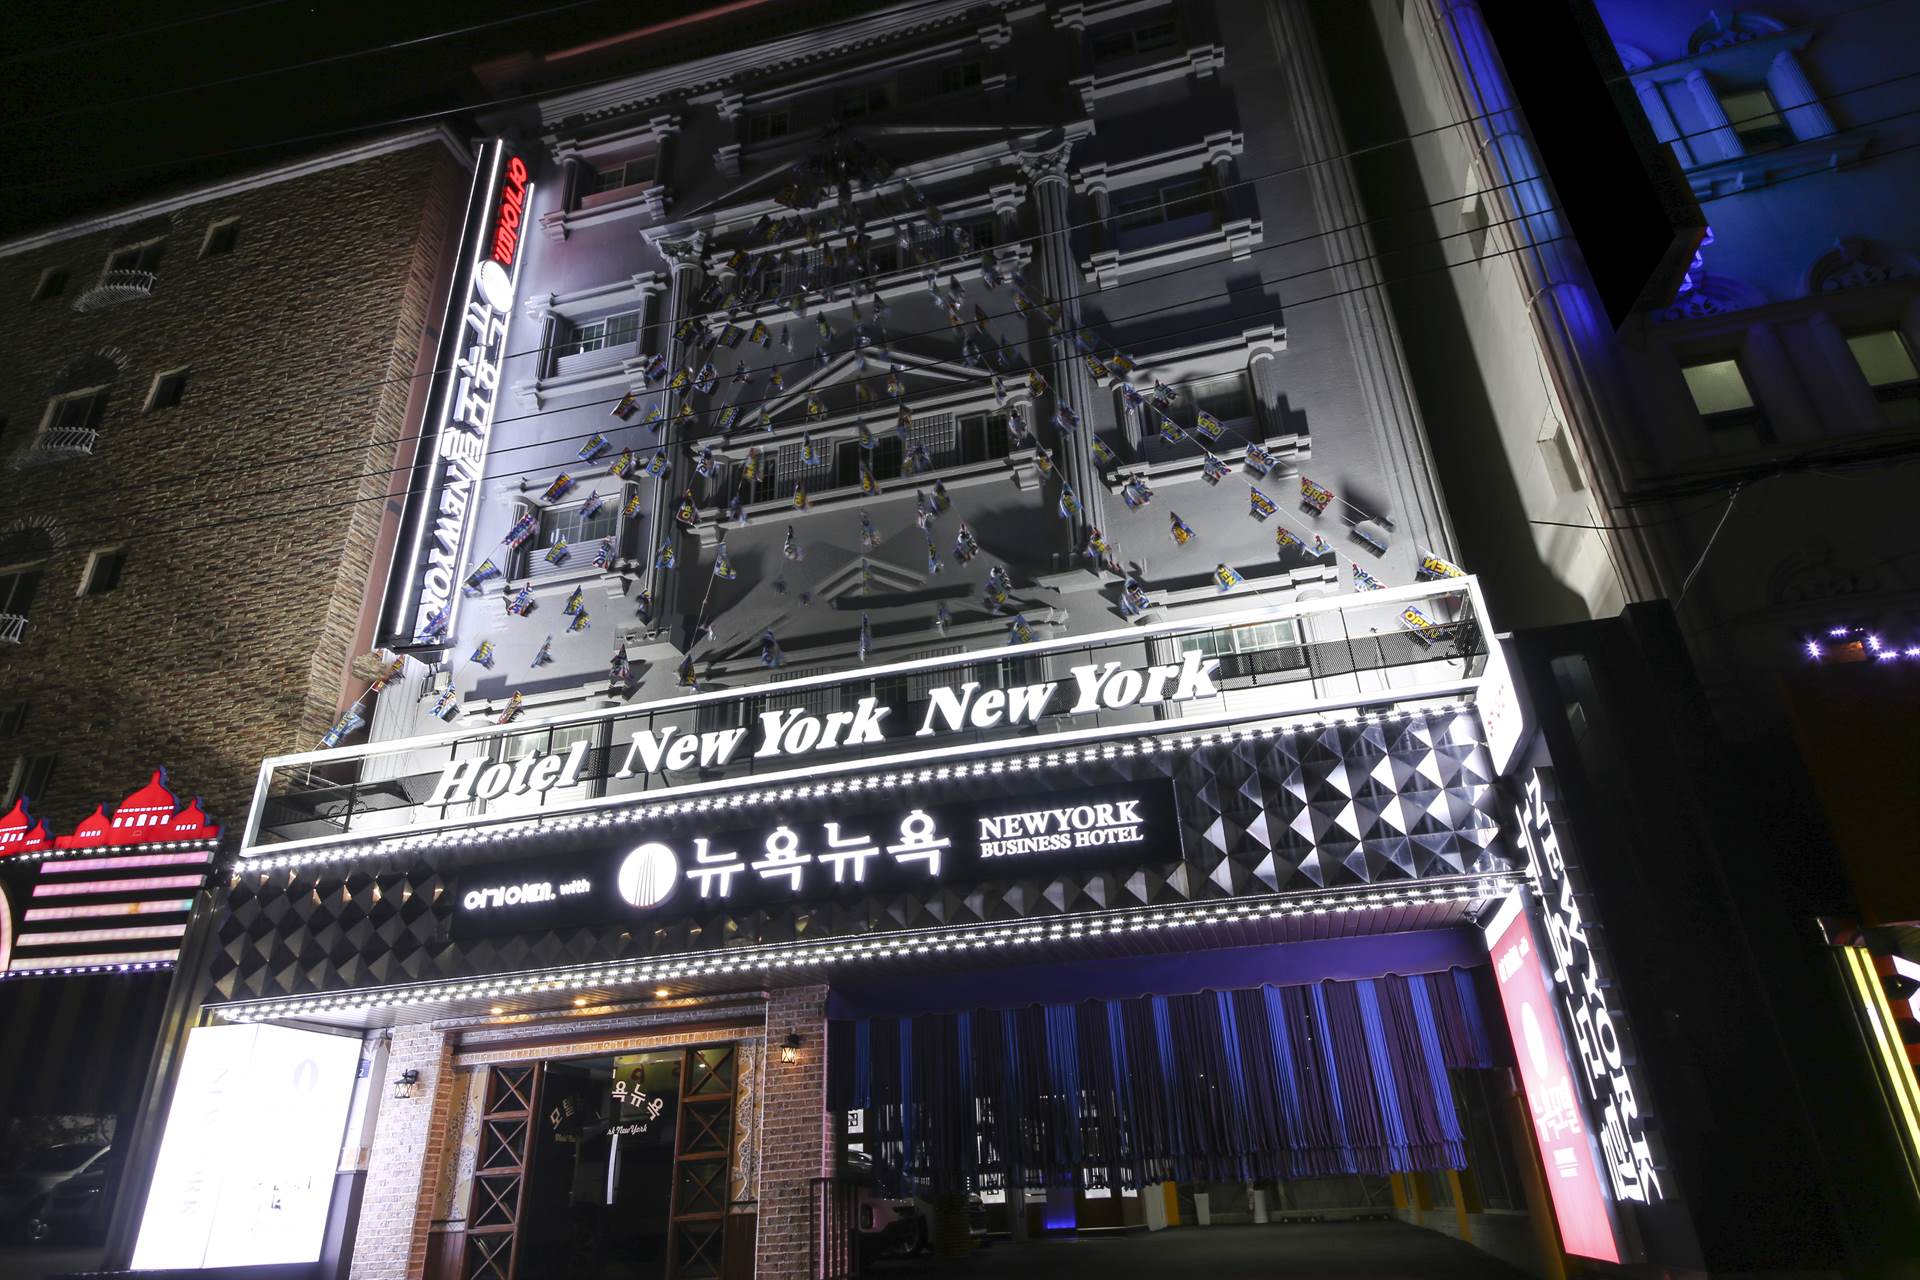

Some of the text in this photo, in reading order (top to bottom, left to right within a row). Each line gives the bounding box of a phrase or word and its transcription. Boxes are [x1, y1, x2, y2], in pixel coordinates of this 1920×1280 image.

[439, 302, 506, 478] 뉴욕모텔
[424, 650, 1220, 806] Hotel New York New York
[559, 878, 590, 895] with
[686, 809, 951, 898] 뉴욕뉴욕
[980, 825, 1144, 858] BUSINESS HOTEL
[1515, 798, 1645, 1201] 뉴욕모텔
